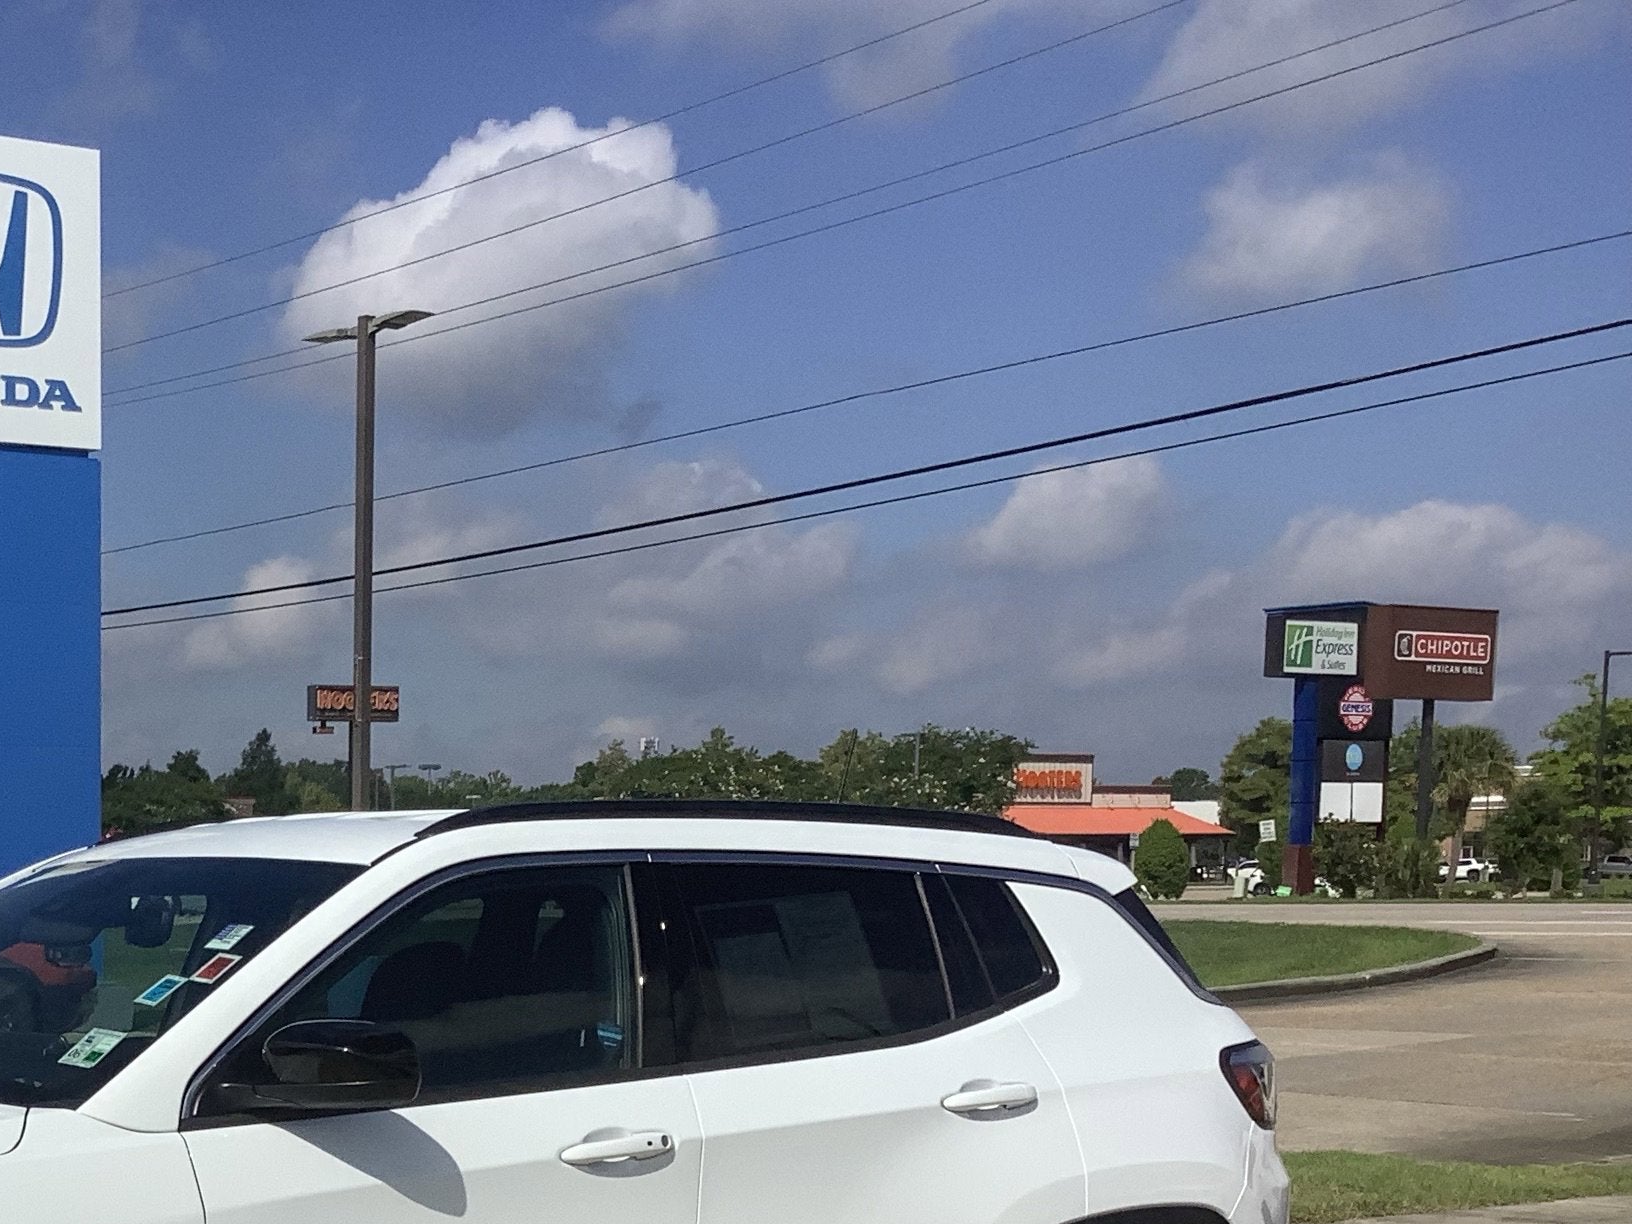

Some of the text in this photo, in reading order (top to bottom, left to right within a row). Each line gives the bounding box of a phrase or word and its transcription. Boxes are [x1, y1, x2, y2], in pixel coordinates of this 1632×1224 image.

[1315, 639, 1354, 657] Express
[1417, 639, 1486, 656] CHIPOTLE
[1426, 665, 1484, 675] MEXICAN GRILL
[317, 689, 399, 710] HOOERS
